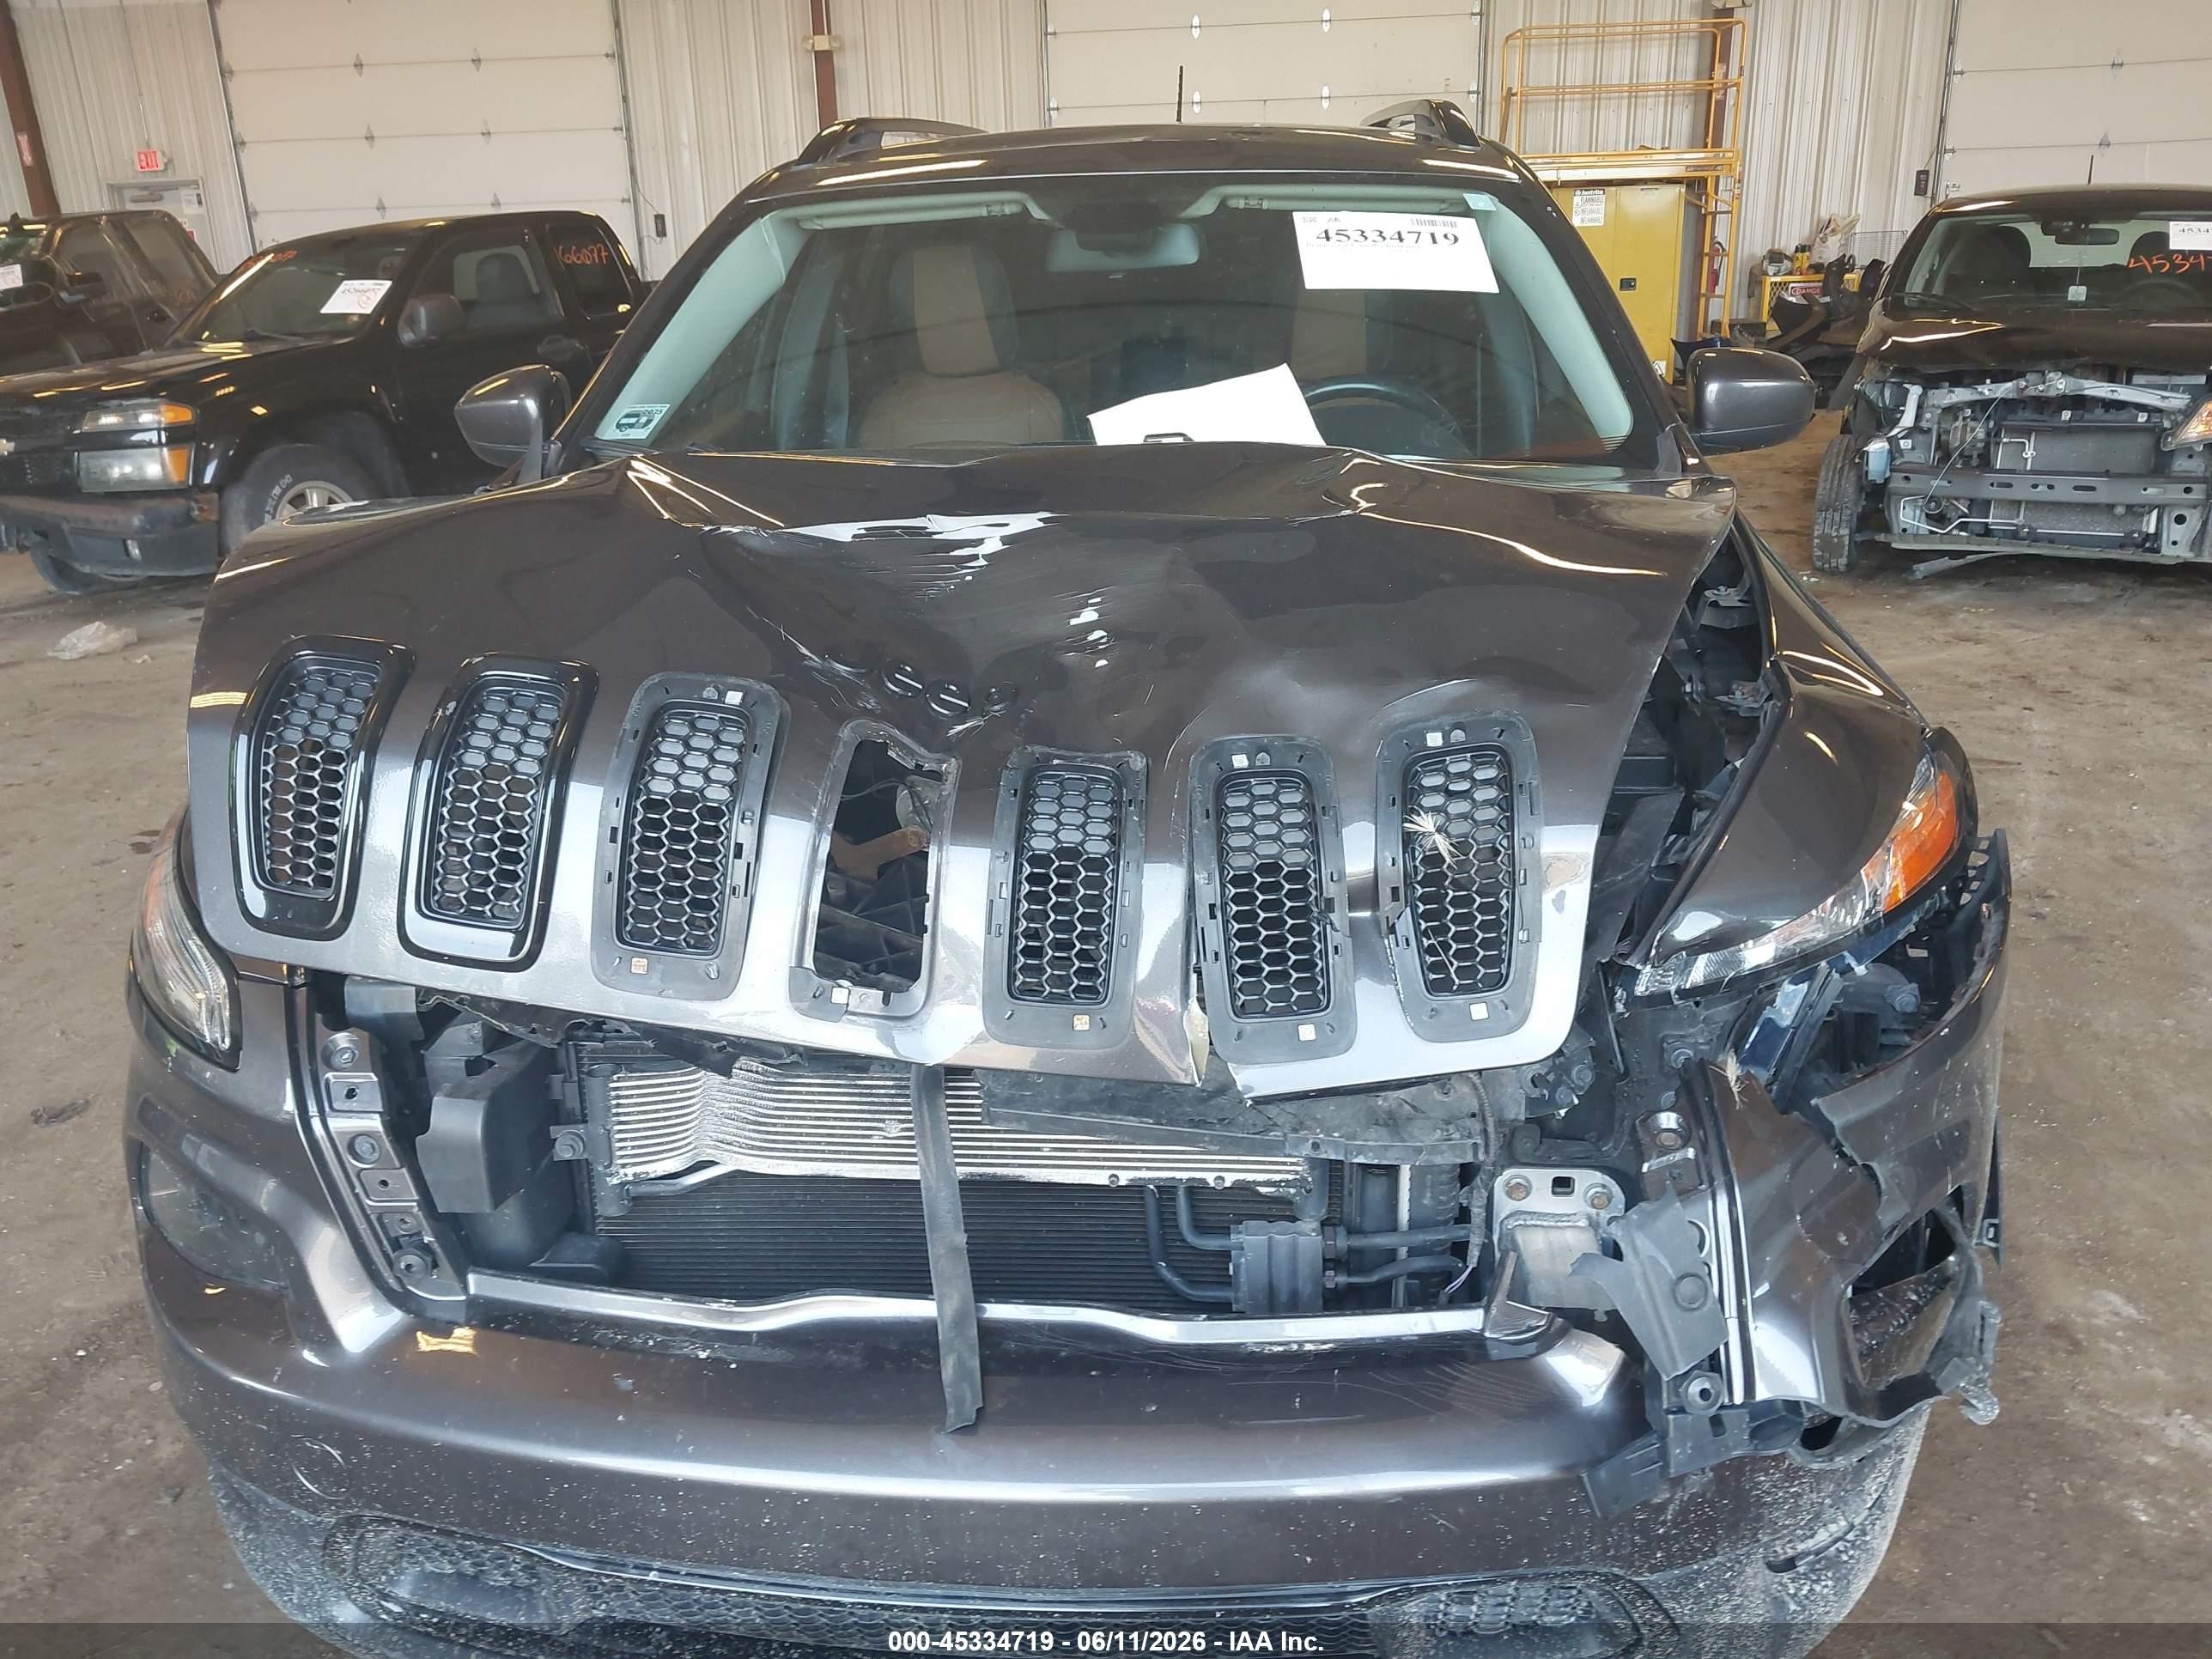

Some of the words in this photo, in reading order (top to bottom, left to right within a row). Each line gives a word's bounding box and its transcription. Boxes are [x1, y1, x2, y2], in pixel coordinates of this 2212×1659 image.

[137, 150, 159, 169] EXIT
[1316, 228, 1460, 246] 45334719
[2129, 253, 2212, 274] 4534
[1796, 287, 1822, 295] DANGE
